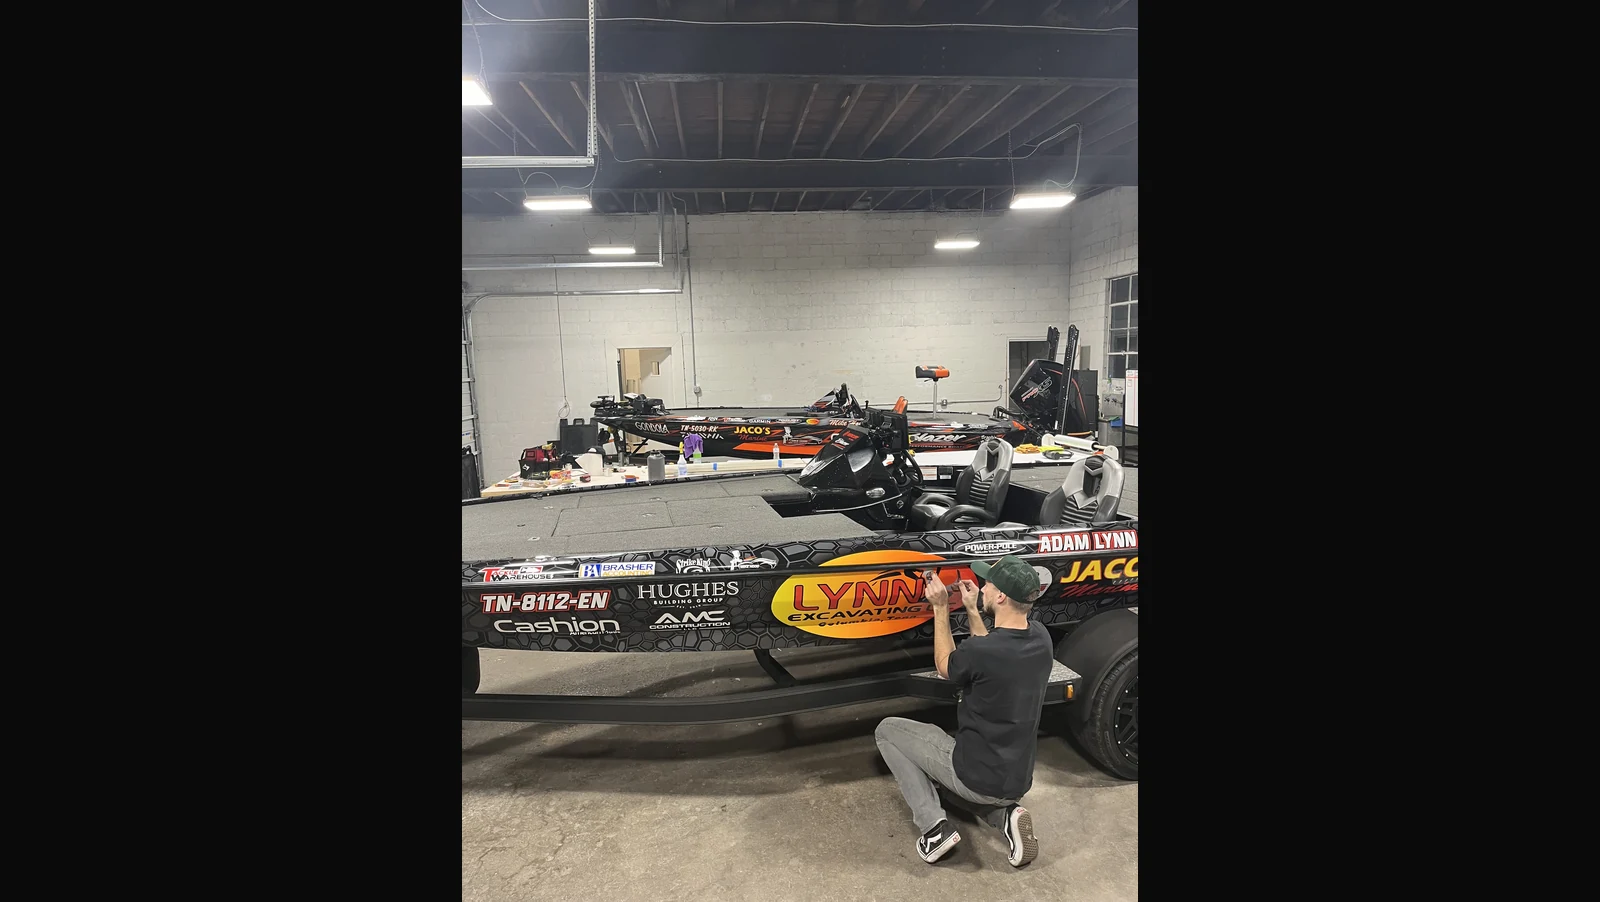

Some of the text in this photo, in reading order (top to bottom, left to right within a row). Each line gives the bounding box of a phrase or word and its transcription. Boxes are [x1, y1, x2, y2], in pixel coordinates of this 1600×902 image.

[733, 426, 771, 435] JACO'S
[964, 543, 1017, 552] POWER-POLE
[1039, 531, 1137, 553] ADAM LYNN
[602, 563, 654, 571] BRASHER
[675, 558, 696, 574] Strike
[481, 567, 519, 582] TACKLE
[491, 573, 552, 582] WAREHOUSE
[637, 581, 739, 599] HUGHES
[793, 578, 924, 611] LYNN
[481, 591, 610, 613] TN-8112-EN
[654, 610, 725, 624] AMC
[787, 605, 923, 622] EXCAVATING
[493, 616, 621, 633] Cashion
[649, 621, 731, 630] CONSTRUCTION
[818, 616, 884, 627] Columbia,
